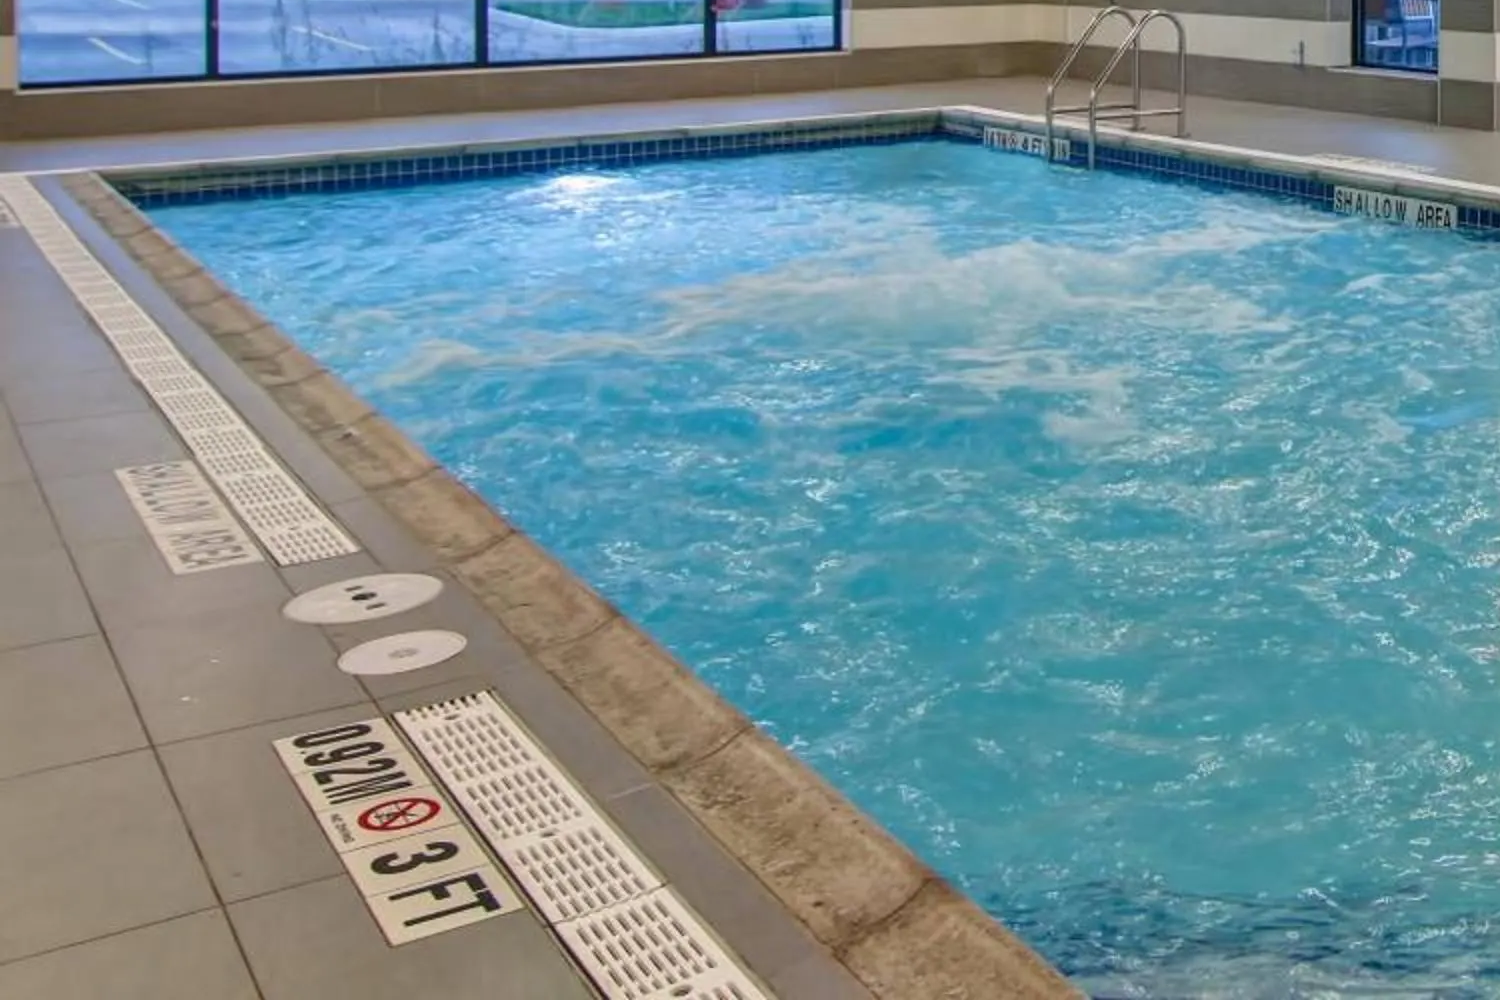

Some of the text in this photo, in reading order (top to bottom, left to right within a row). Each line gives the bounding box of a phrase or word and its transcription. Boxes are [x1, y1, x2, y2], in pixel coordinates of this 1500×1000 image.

[1335, 189, 1451, 229] SHALLOW AREA
[168, 529, 250, 570] AREA
[370, 841, 460, 875] 3
[388, 872, 502, 928] FT
